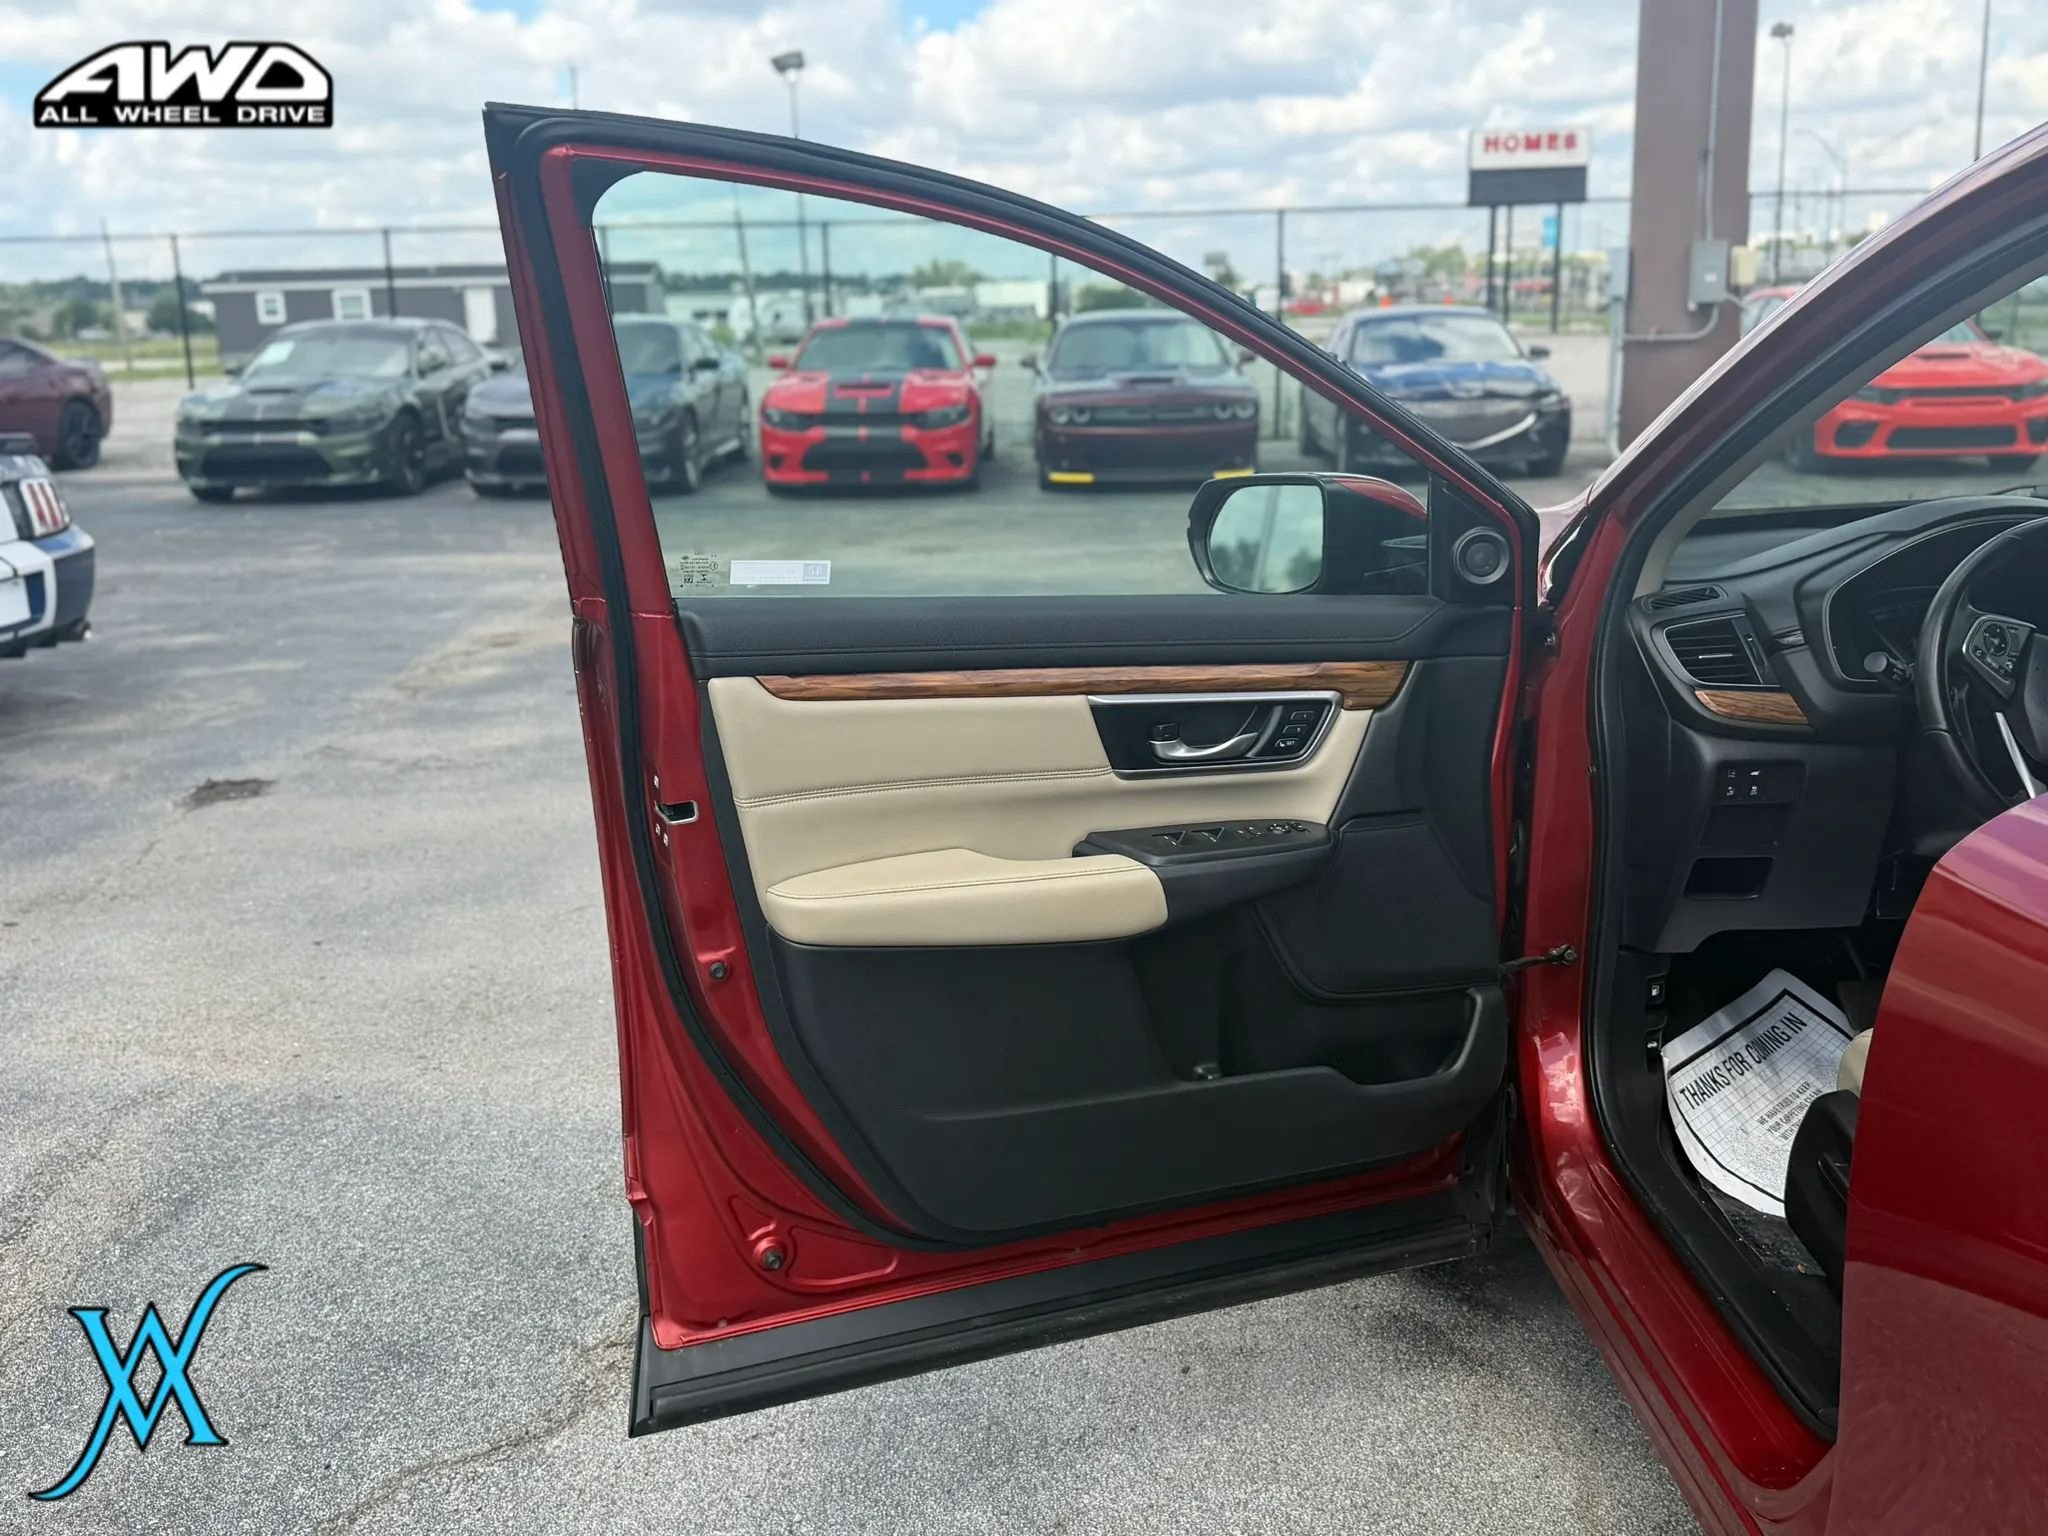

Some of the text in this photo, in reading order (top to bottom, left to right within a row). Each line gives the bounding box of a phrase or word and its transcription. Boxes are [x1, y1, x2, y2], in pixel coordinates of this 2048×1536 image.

[1483, 131, 1577, 153] HOMES
[1679, 1011, 1808, 1110] THANKS FOR COMING IN
[1795, 1080, 1810, 1095] KEEP
